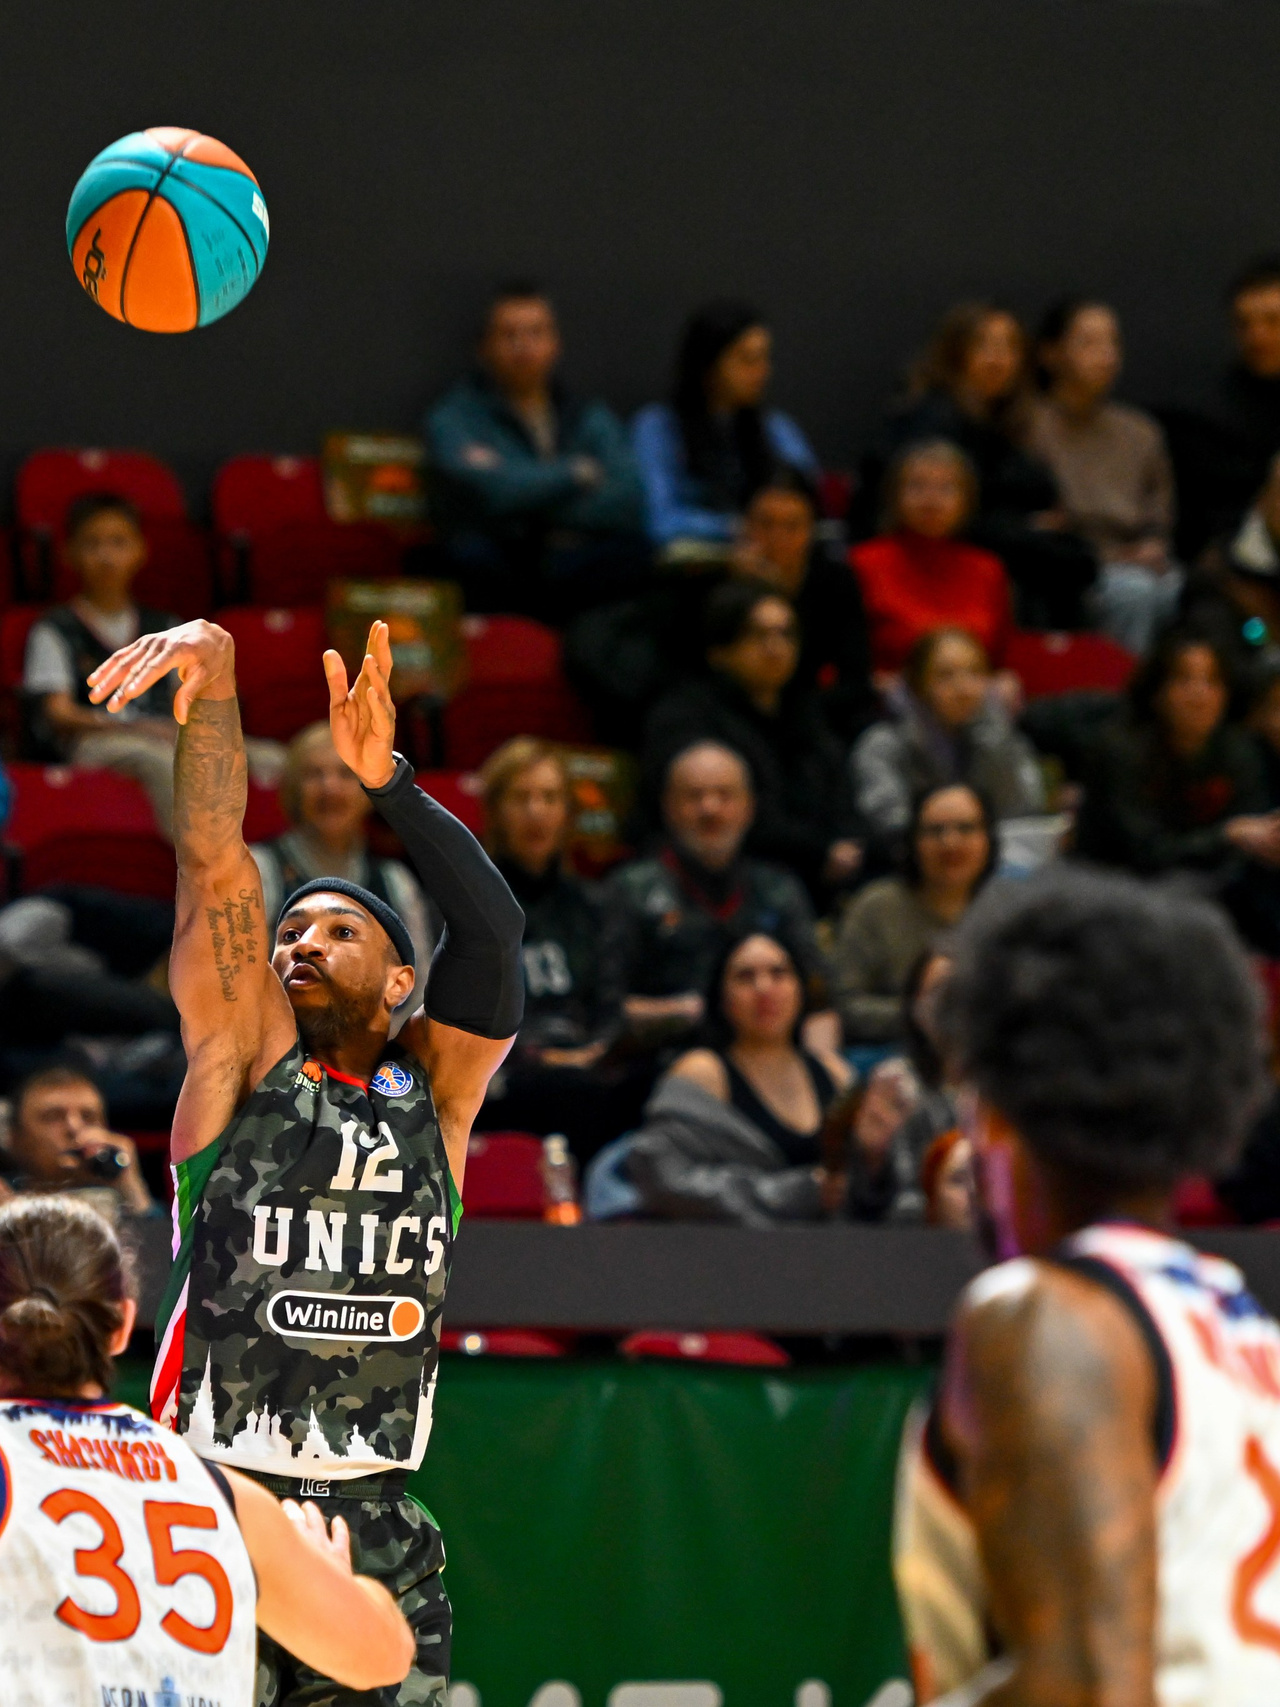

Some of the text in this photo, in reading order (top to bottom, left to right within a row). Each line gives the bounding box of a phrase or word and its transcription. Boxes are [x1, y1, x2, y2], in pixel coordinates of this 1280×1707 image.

[295, 1072, 321, 1093] UNICS
[330, 1121, 403, 1193] 12
[252, 1205, 447, 1276] UNICS
[284, 1301, 384, 1332] Winline
[300, 1478, 330, 1496] 12
[39, 1488, 234, 1656] 35
